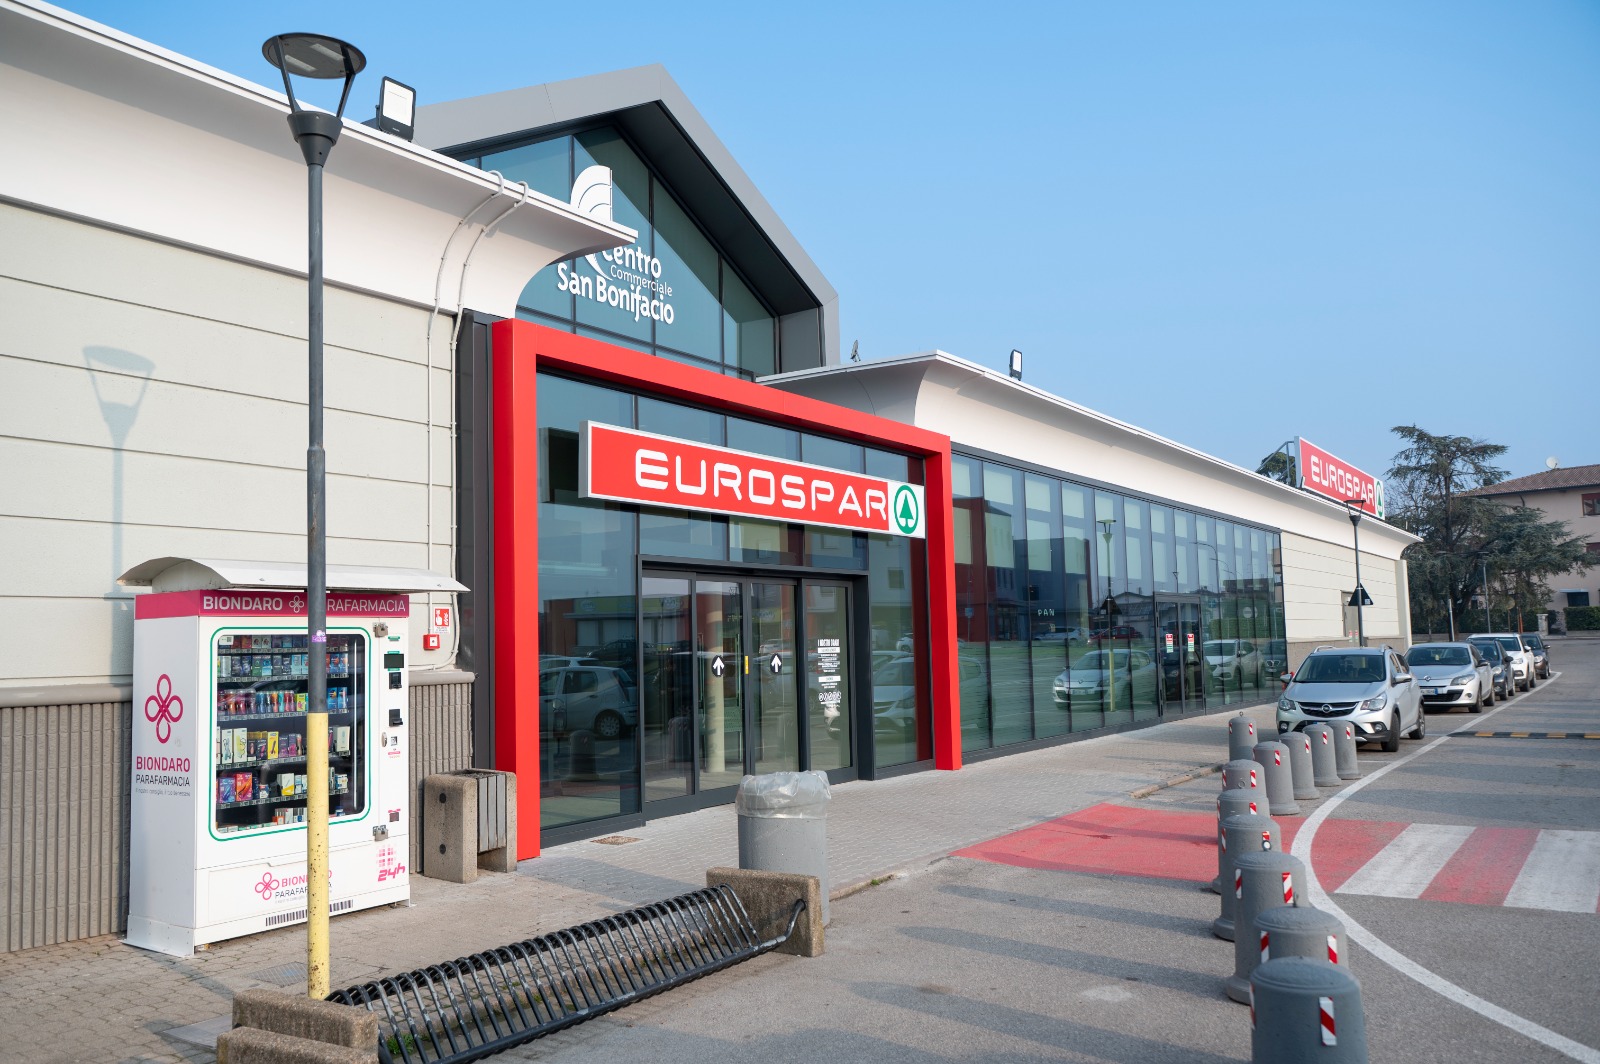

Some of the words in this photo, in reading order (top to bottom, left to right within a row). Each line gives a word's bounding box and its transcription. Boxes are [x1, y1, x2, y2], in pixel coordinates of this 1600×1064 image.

[557, 262, 593, 299] San
[596, 274, 675, 325] Bonifacio
[610, 264, 673, 297] Commerciale
[635, 448, 887, 521] EUROSPAR
[1310, 454, 1375, 507] EUROSPAR
[203, 595, 283, 611] BIONDARO
[327, 598, 406, 612] RAFARMACIA
[136, 756, 191, 772] BIONDARO
[135, 774, 191, 787] PARAFARMACIA
[377, 862, 406, 882] 24h
